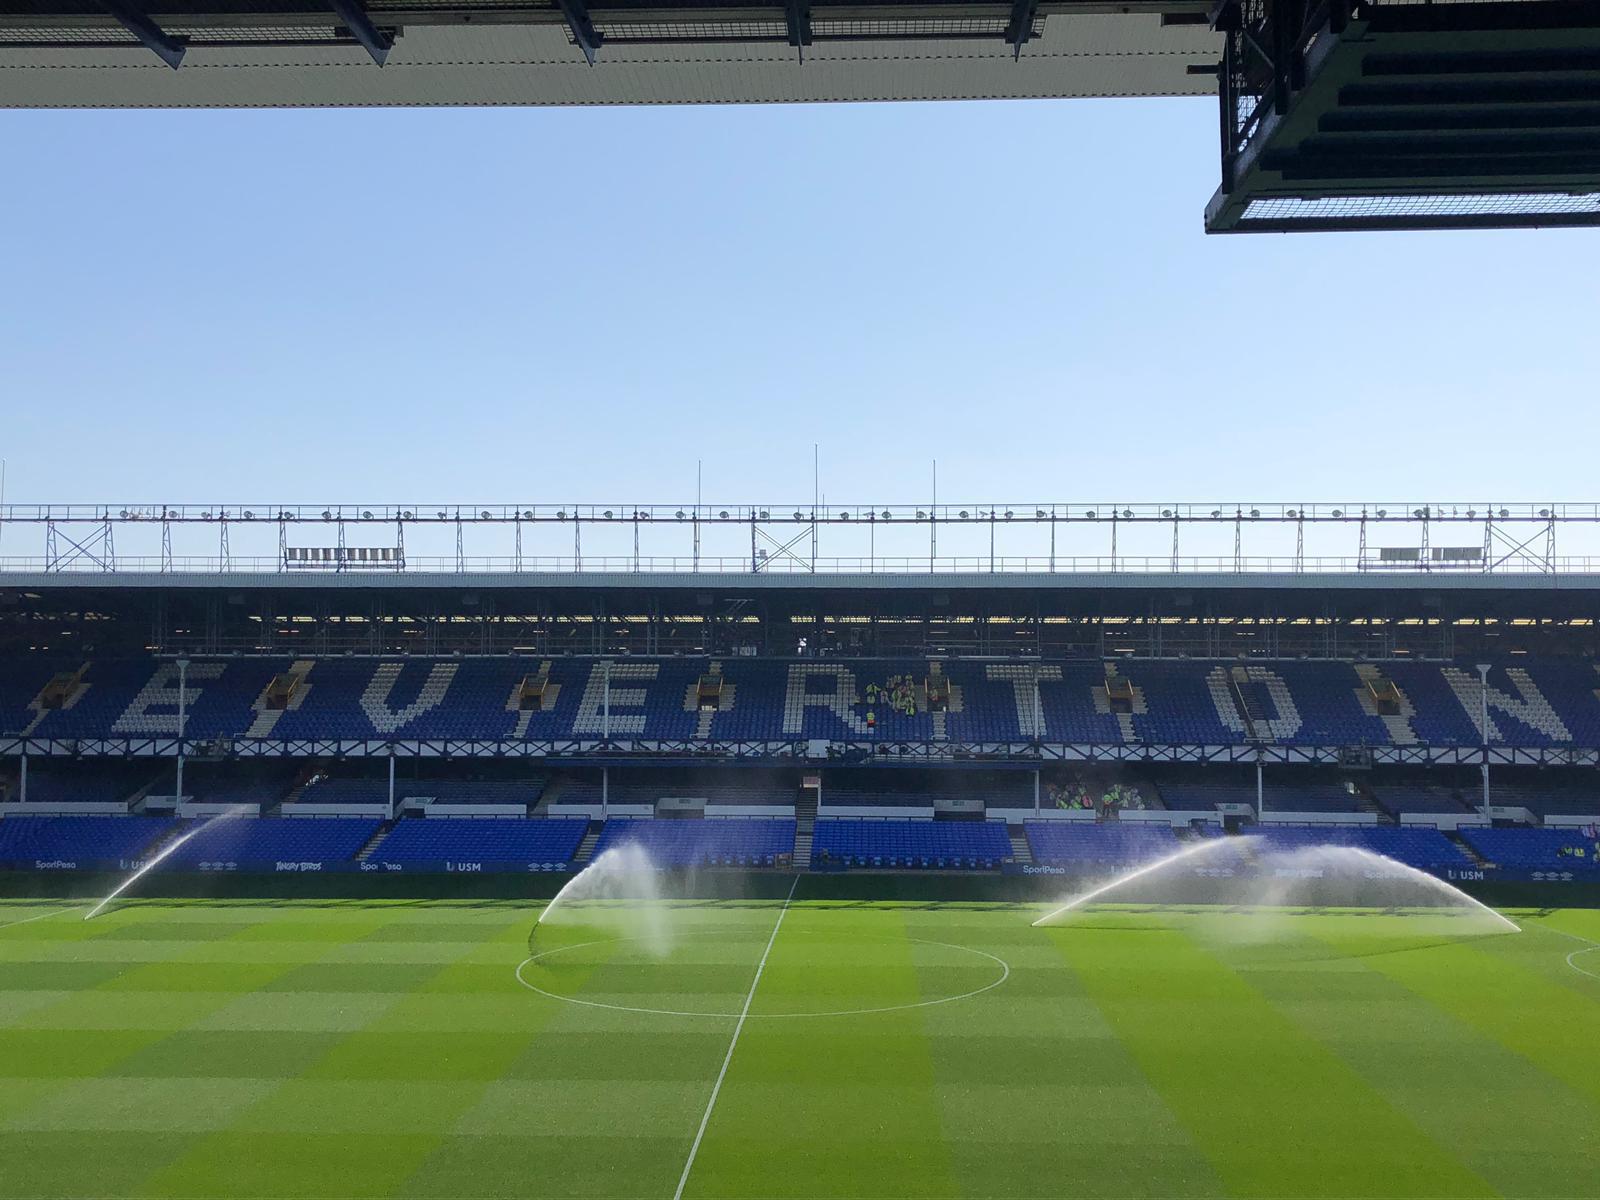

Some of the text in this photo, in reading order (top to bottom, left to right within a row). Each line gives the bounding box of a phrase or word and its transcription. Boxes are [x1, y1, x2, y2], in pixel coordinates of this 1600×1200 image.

[110, 661, 1573, 743] EVERTON
[35, 860, 77, 870] SportPesa
[360, 861, 402, 872] Spoesa
[457, 862, 481, 872] USM
[1022, 864, 1066, 875] SportPesa
[1460, 870, 1484, 881] USM
